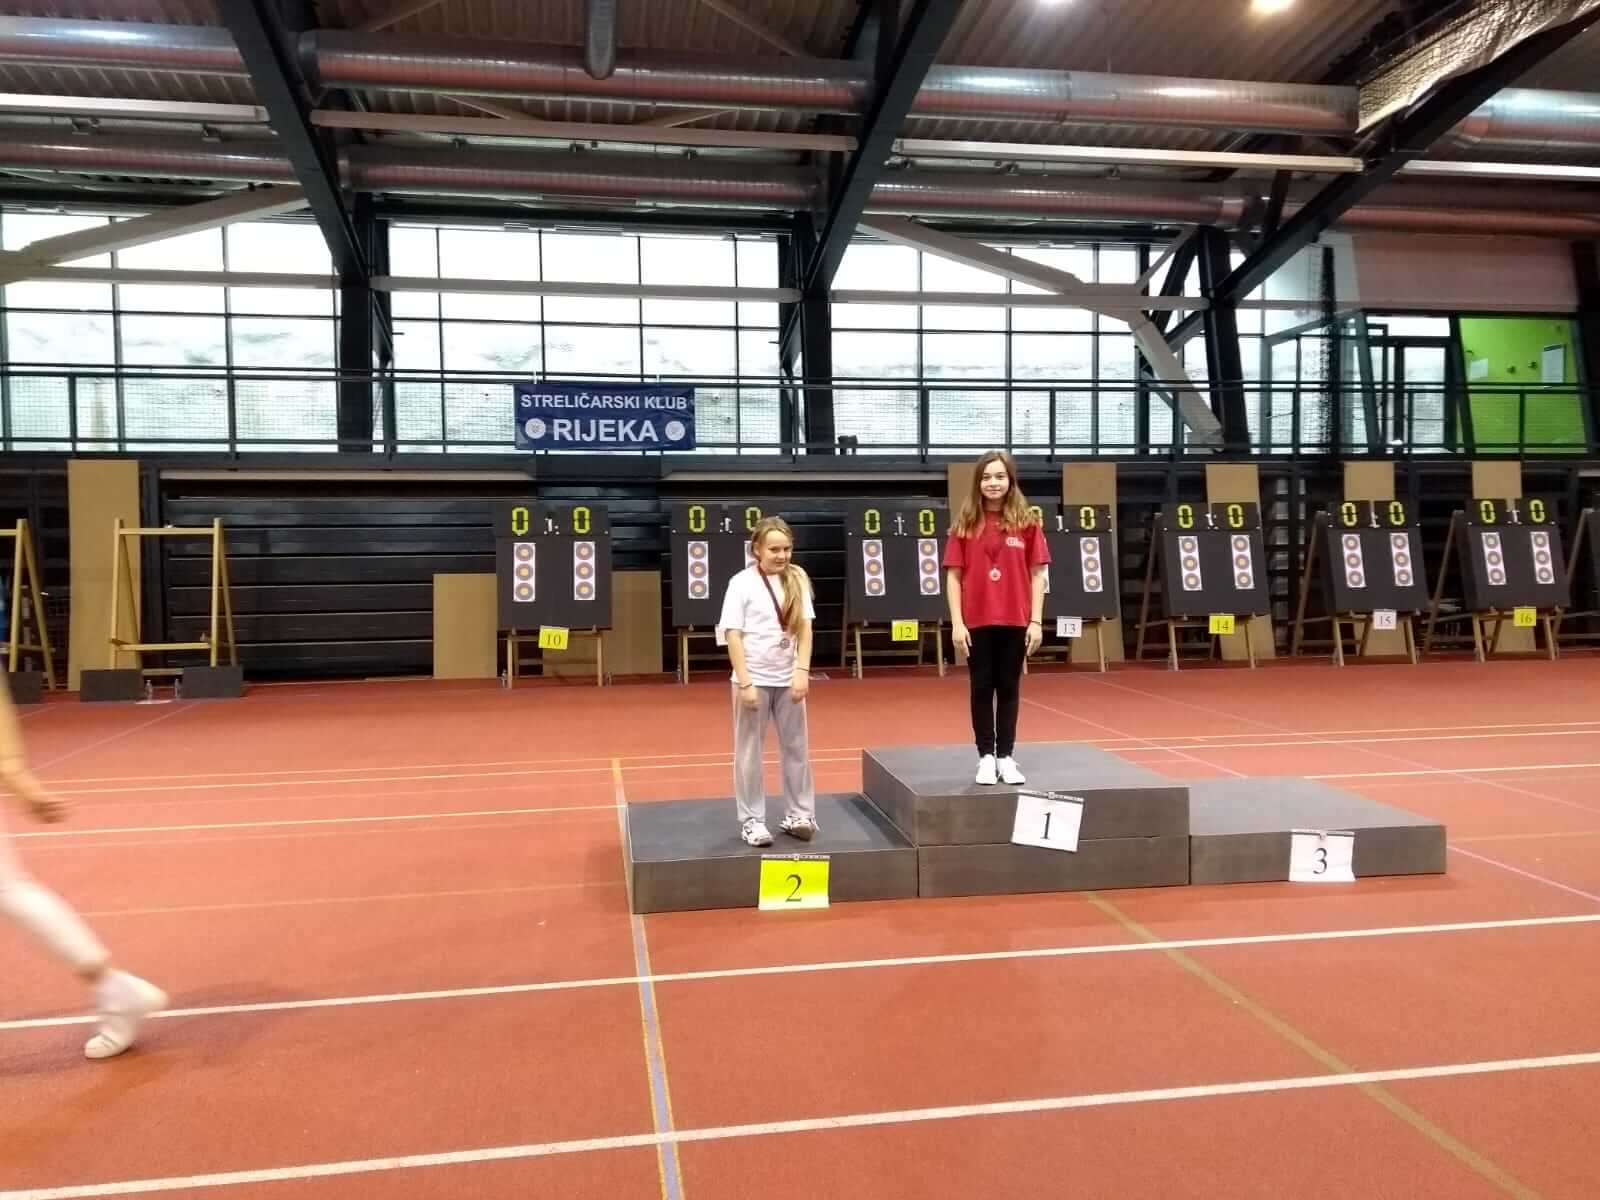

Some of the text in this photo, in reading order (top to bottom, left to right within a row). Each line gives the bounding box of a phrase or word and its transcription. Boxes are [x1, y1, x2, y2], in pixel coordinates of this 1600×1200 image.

[520, 393, 687, 410] STRELIČARSKI KLUB
[553, 419, 659, 441] RIJEKA
[511, 507, 591, 534] 0 0
[688, 506, 761, 532] 0 0
[864, 508, 935, 535] 0 0
[1080, 506, 1096, 530] 0
[1177, 504, 1243, 529] 0 0
[1342, 502, 1404, 527] 0 0
[1481, 500, 1545, 524] 0 0
[1062, 623, 1076, 634] 13
[1215, 619, 1229, 631] 14
[1379, 614, 1392, 625] 15
[1519, 613, 1531, 624] 16
[545, 633, 561, 646] 10
[899, 627, 913, 638] 12
[1041, 812, 1051, 840] 1
[1314, 848, 1328, 874] 3
[785, 874, 803, 902] 2
